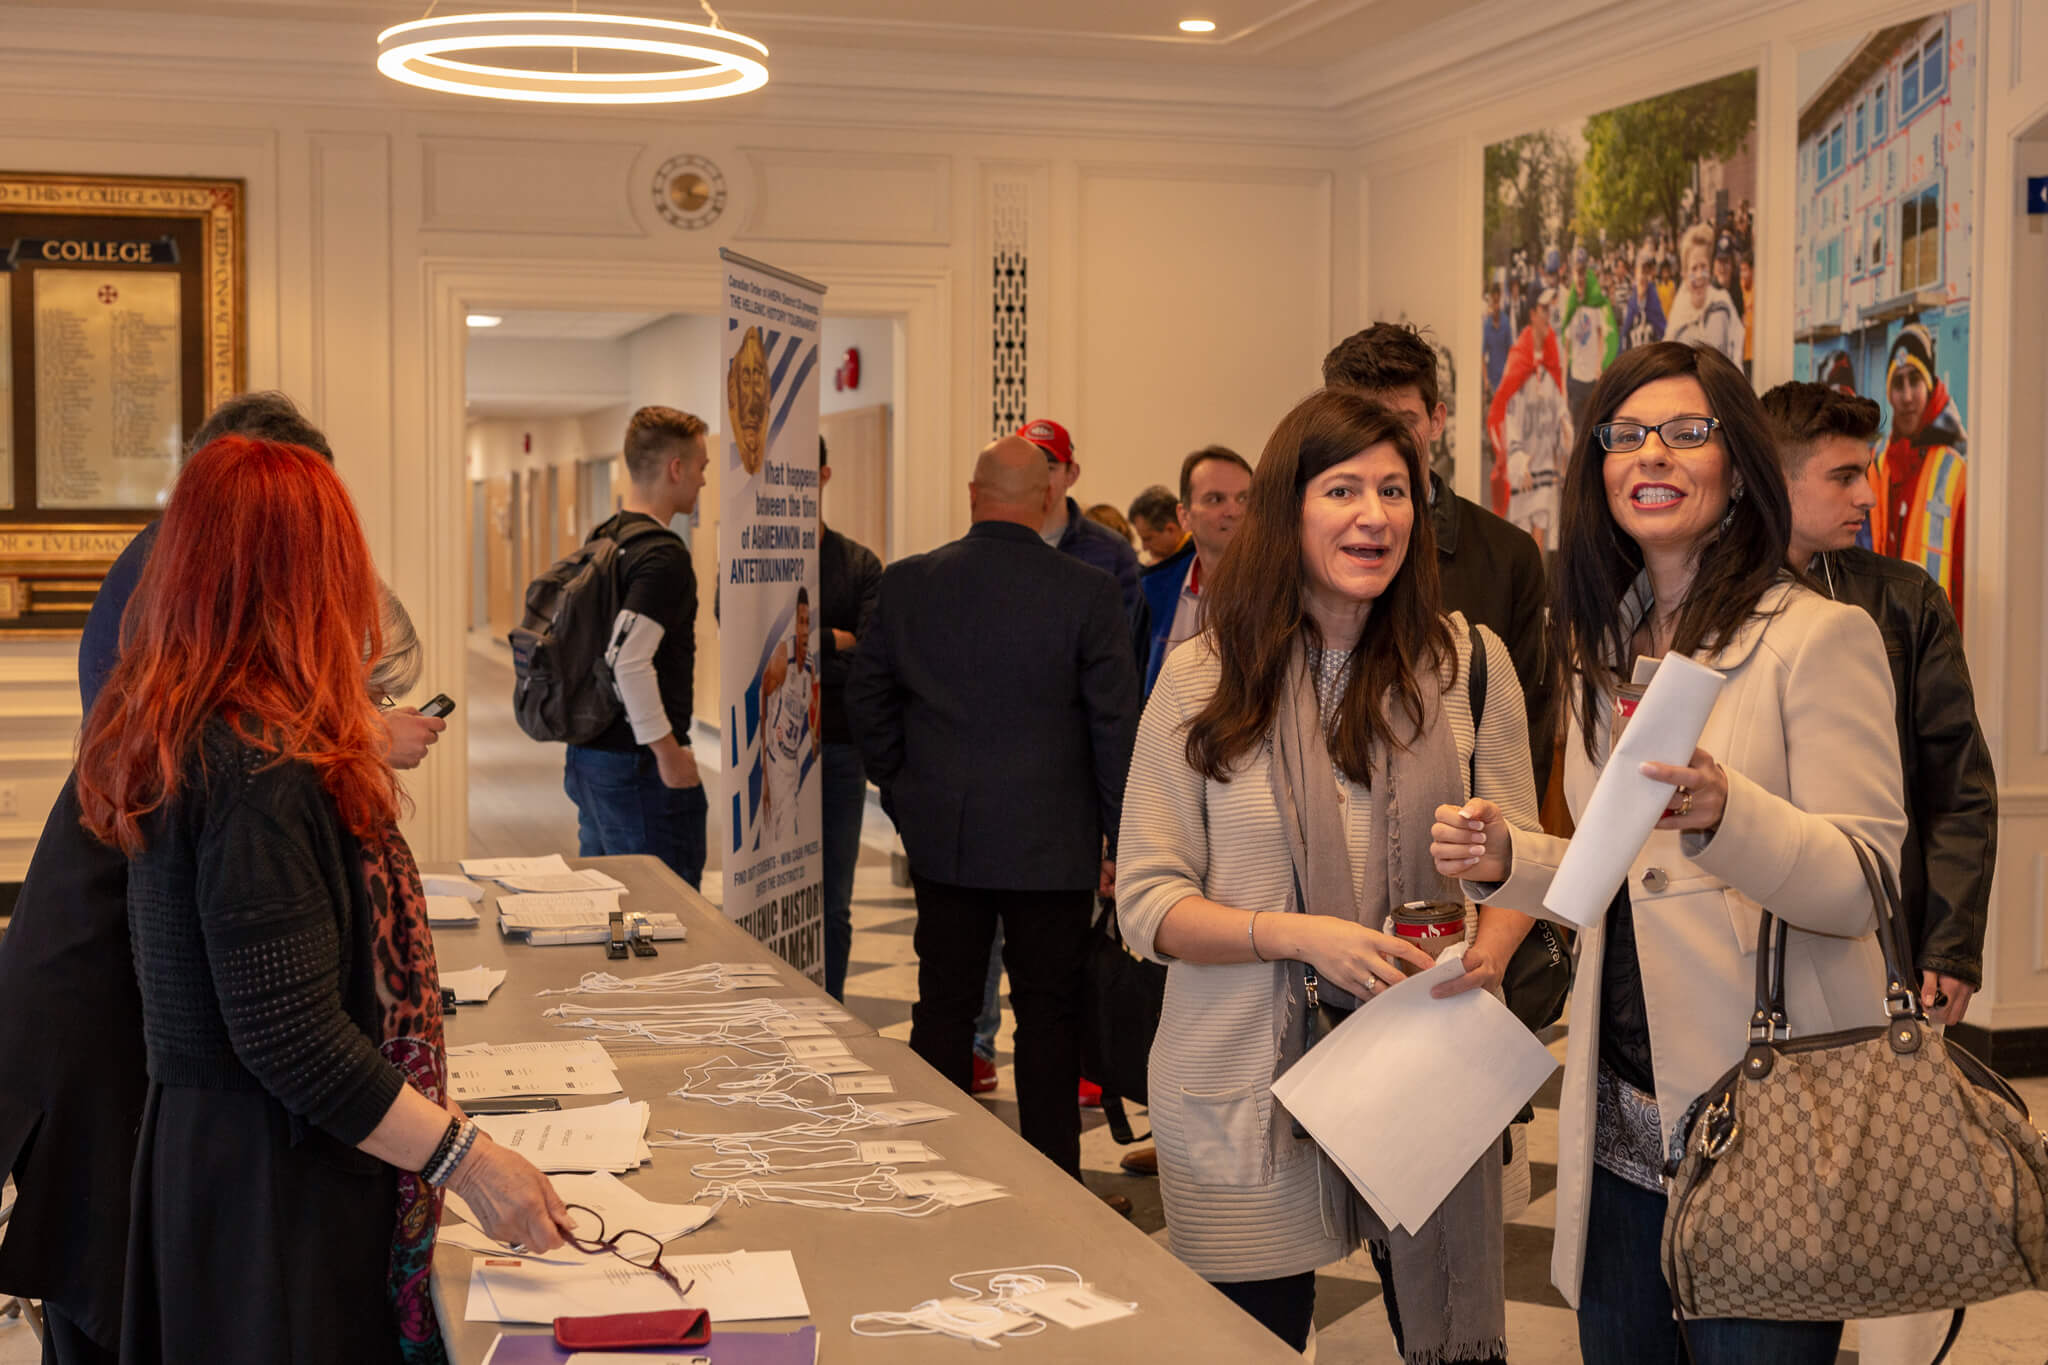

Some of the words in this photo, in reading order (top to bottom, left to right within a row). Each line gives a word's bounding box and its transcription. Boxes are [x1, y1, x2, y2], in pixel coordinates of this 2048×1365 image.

[41, 239, 153, 264] COLLEGE
[741, 525, 750, 550] of
[802, 529, 816, 550] and
